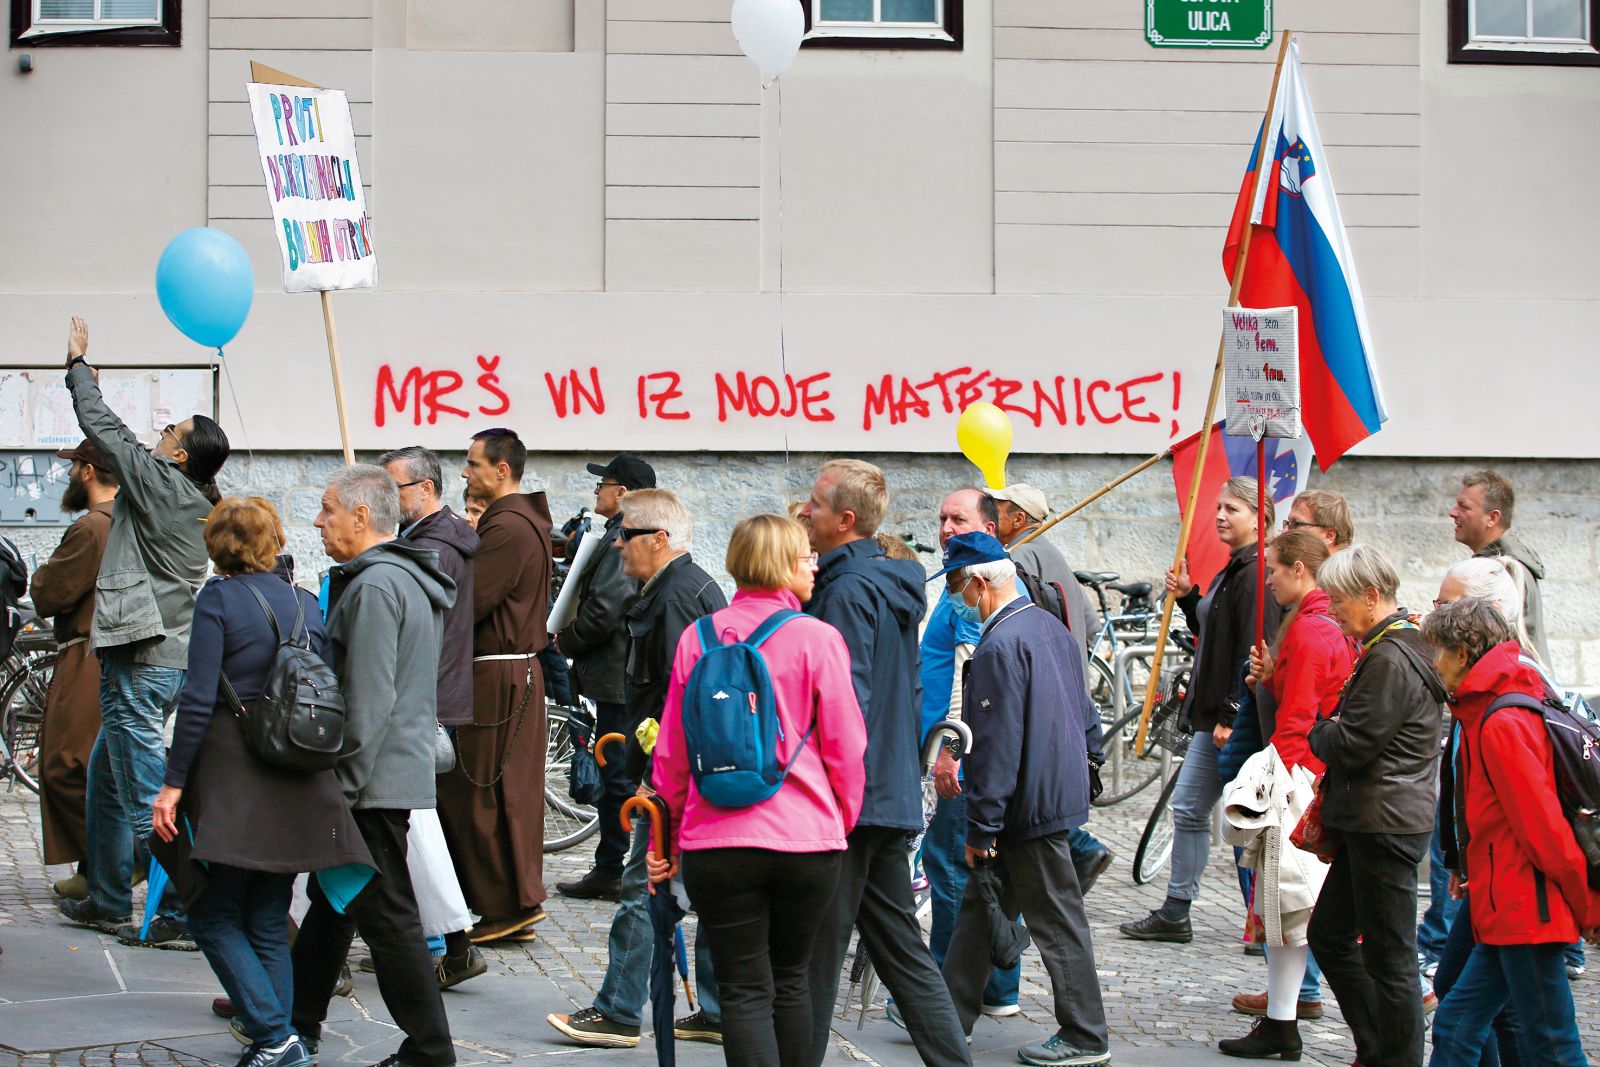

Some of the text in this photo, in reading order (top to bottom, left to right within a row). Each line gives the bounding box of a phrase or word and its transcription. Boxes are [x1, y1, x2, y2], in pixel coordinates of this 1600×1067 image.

[1188, 11, 1231, 31] ULICA
[269, 93, 324, 146] PROTI
[283, 217, 334, 271] BOLNIH
[1231, 313, 1279, 331] Velika sem
[374, 354, 1182, 439] MRŠ VN IZ MOJE MATERNICE!
